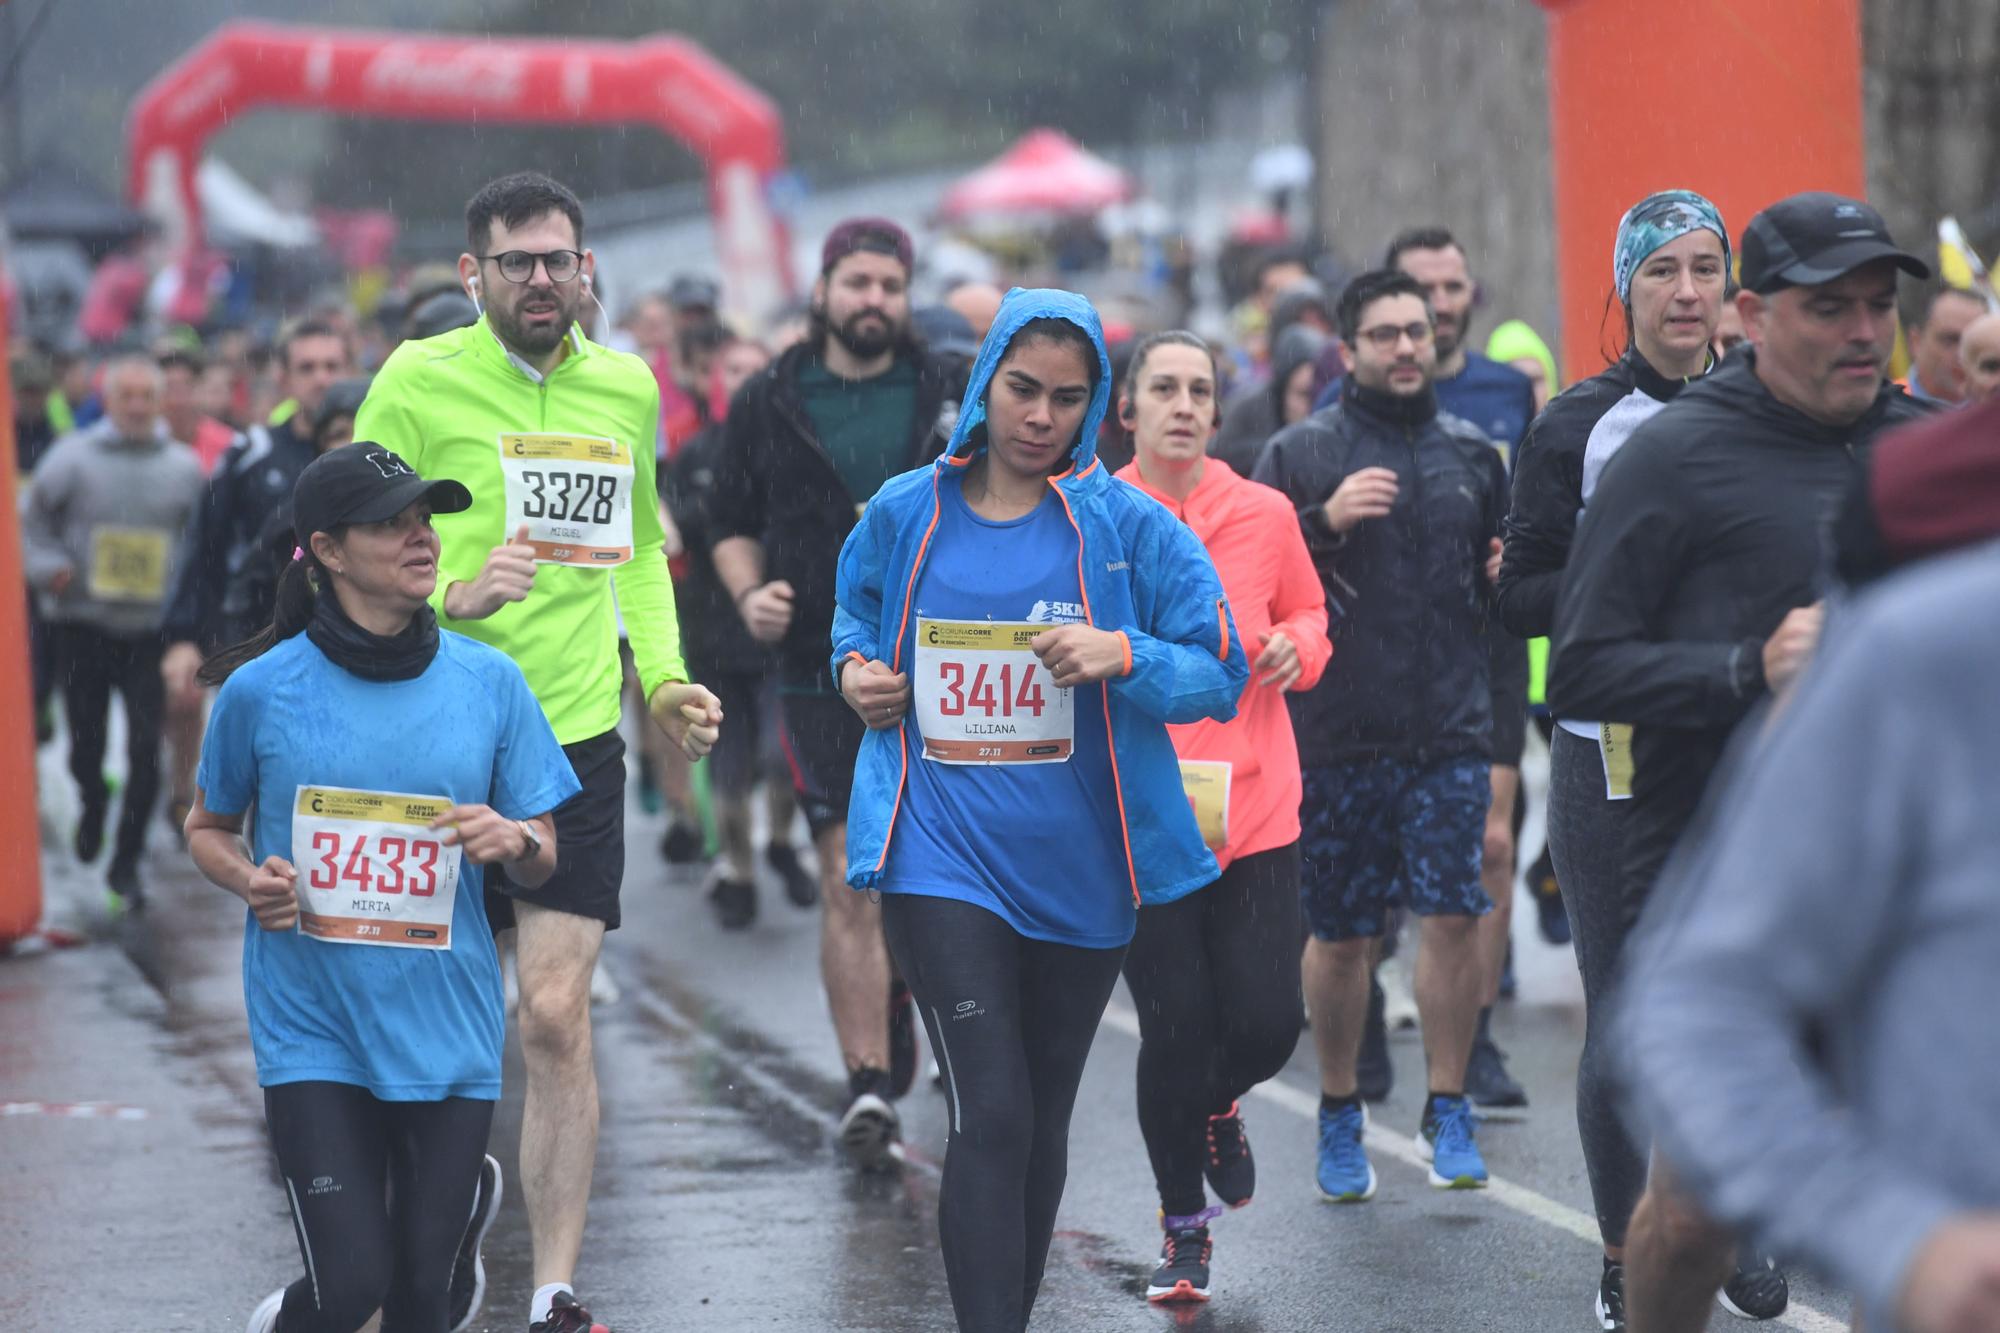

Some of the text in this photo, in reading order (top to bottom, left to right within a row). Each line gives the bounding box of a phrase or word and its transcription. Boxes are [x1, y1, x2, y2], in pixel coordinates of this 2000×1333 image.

[522, 471, 617, 525] 3328
[550, 527, 582, 538] MIGUEL
[940, 662, 1045, 717] 3414
[965, 723, 1016, 735] LILIANA
[978, 747, 1001, 757] 27.11
[310, 832, 439, 897] 3433
[352, 900, 391, 913] MIRTA
[356, 925, 381, 937] 27.11
